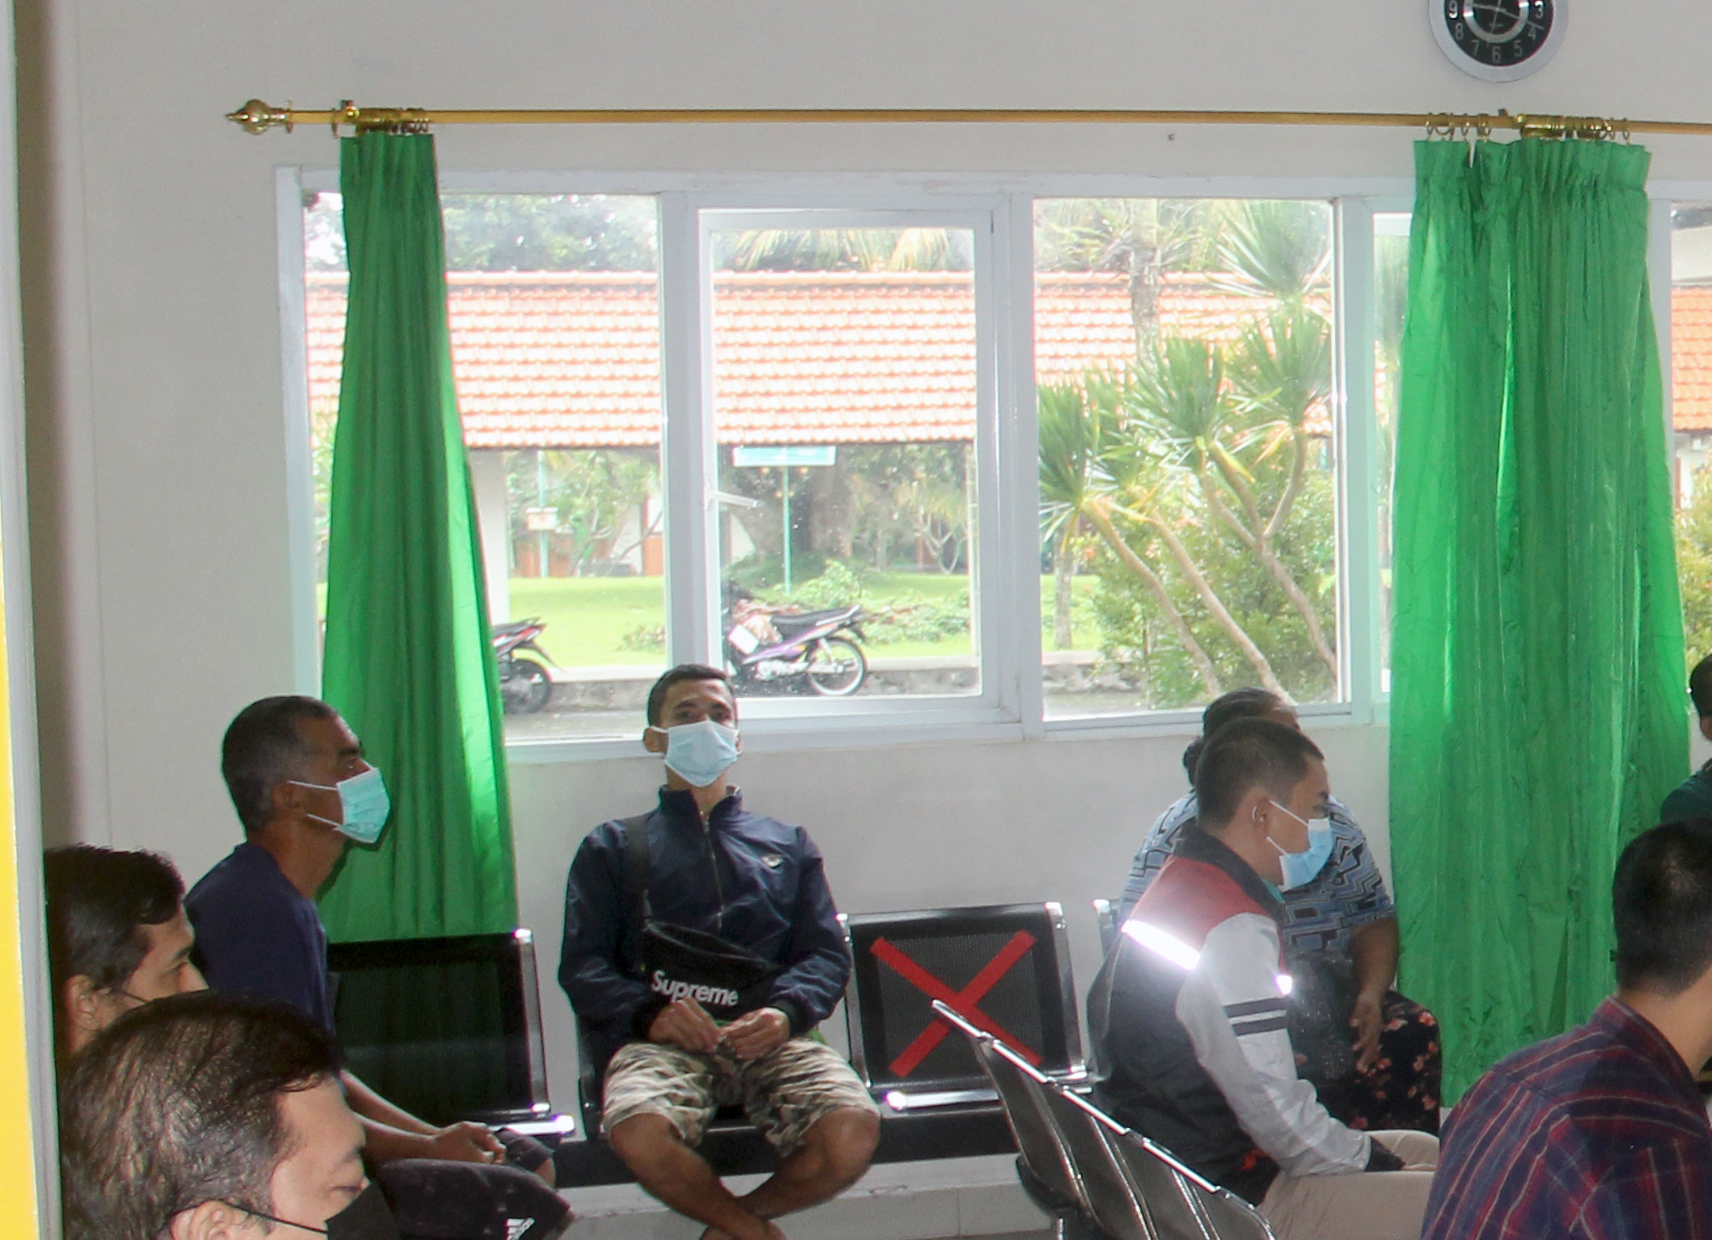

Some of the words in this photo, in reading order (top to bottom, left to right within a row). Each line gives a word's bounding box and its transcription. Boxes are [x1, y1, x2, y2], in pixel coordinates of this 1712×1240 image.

[1448, 1, 1458, 19] 9
[1534, 1, 1544, 19] 3
[1454, 22, 1464, 40] 8
[1527, 27, 1537, 41] 4
[1471, 39, 1480, 56] 7
[1492, 46, 1501, 63] 6
[1513, 40, 1523, 57] 5
[651, 970, 739, 1007] Supreme
